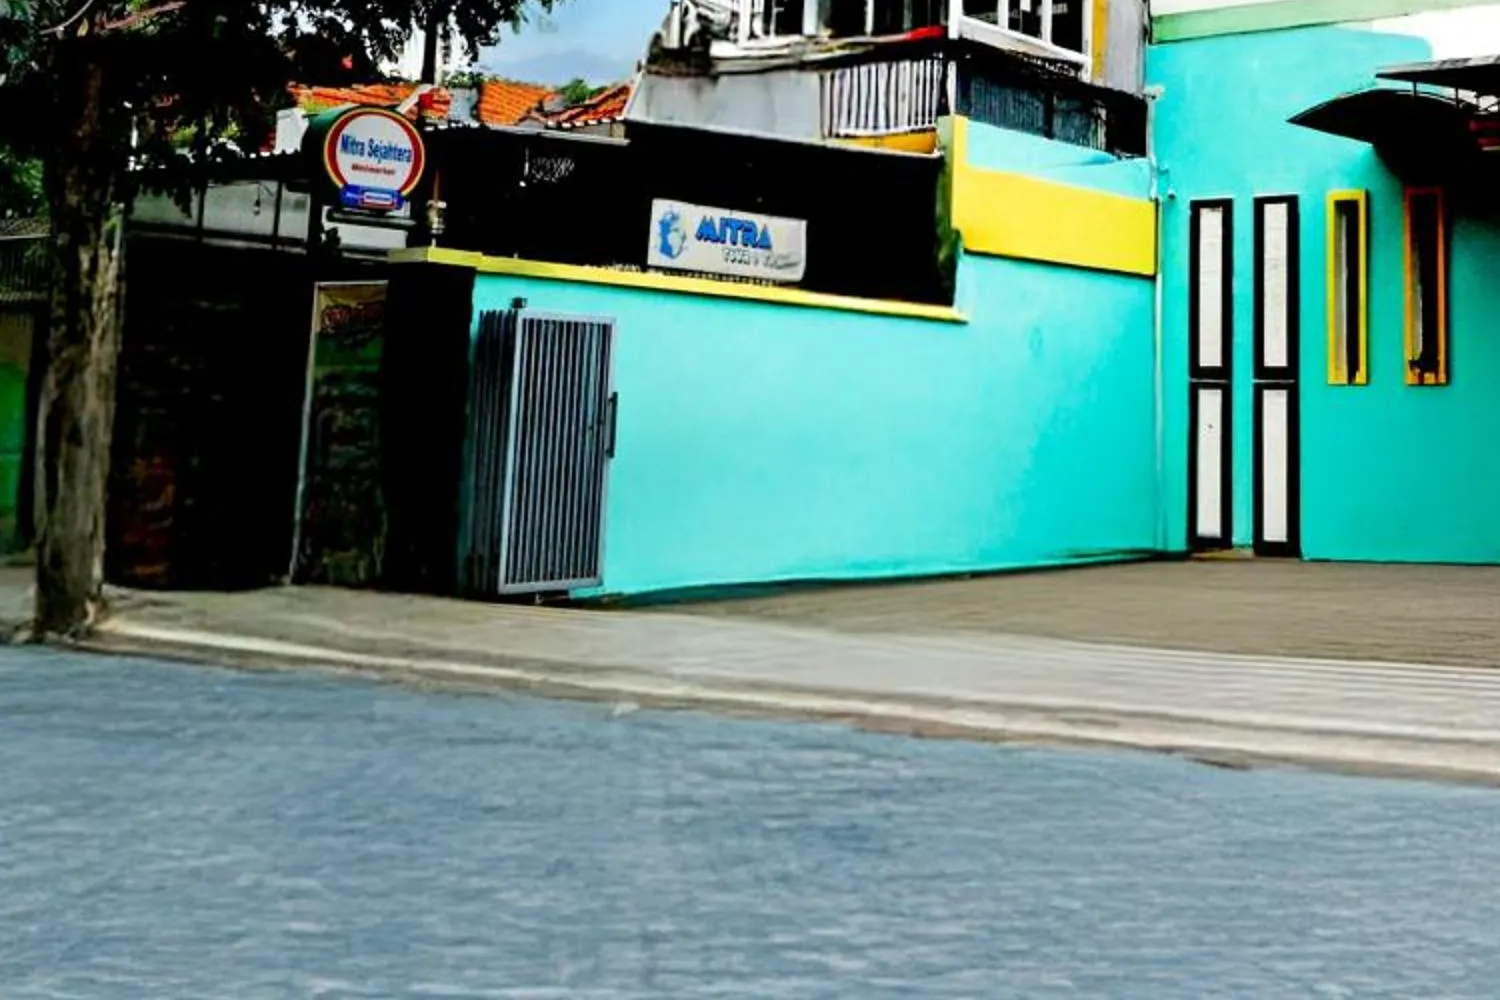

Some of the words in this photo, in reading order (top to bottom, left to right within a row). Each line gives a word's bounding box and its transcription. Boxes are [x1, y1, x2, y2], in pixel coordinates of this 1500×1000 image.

[341, 134, 365, 157] Mitra
[367, 137, 412, 164] Sejahtera
[695, 215, 772, 250] MITRA
